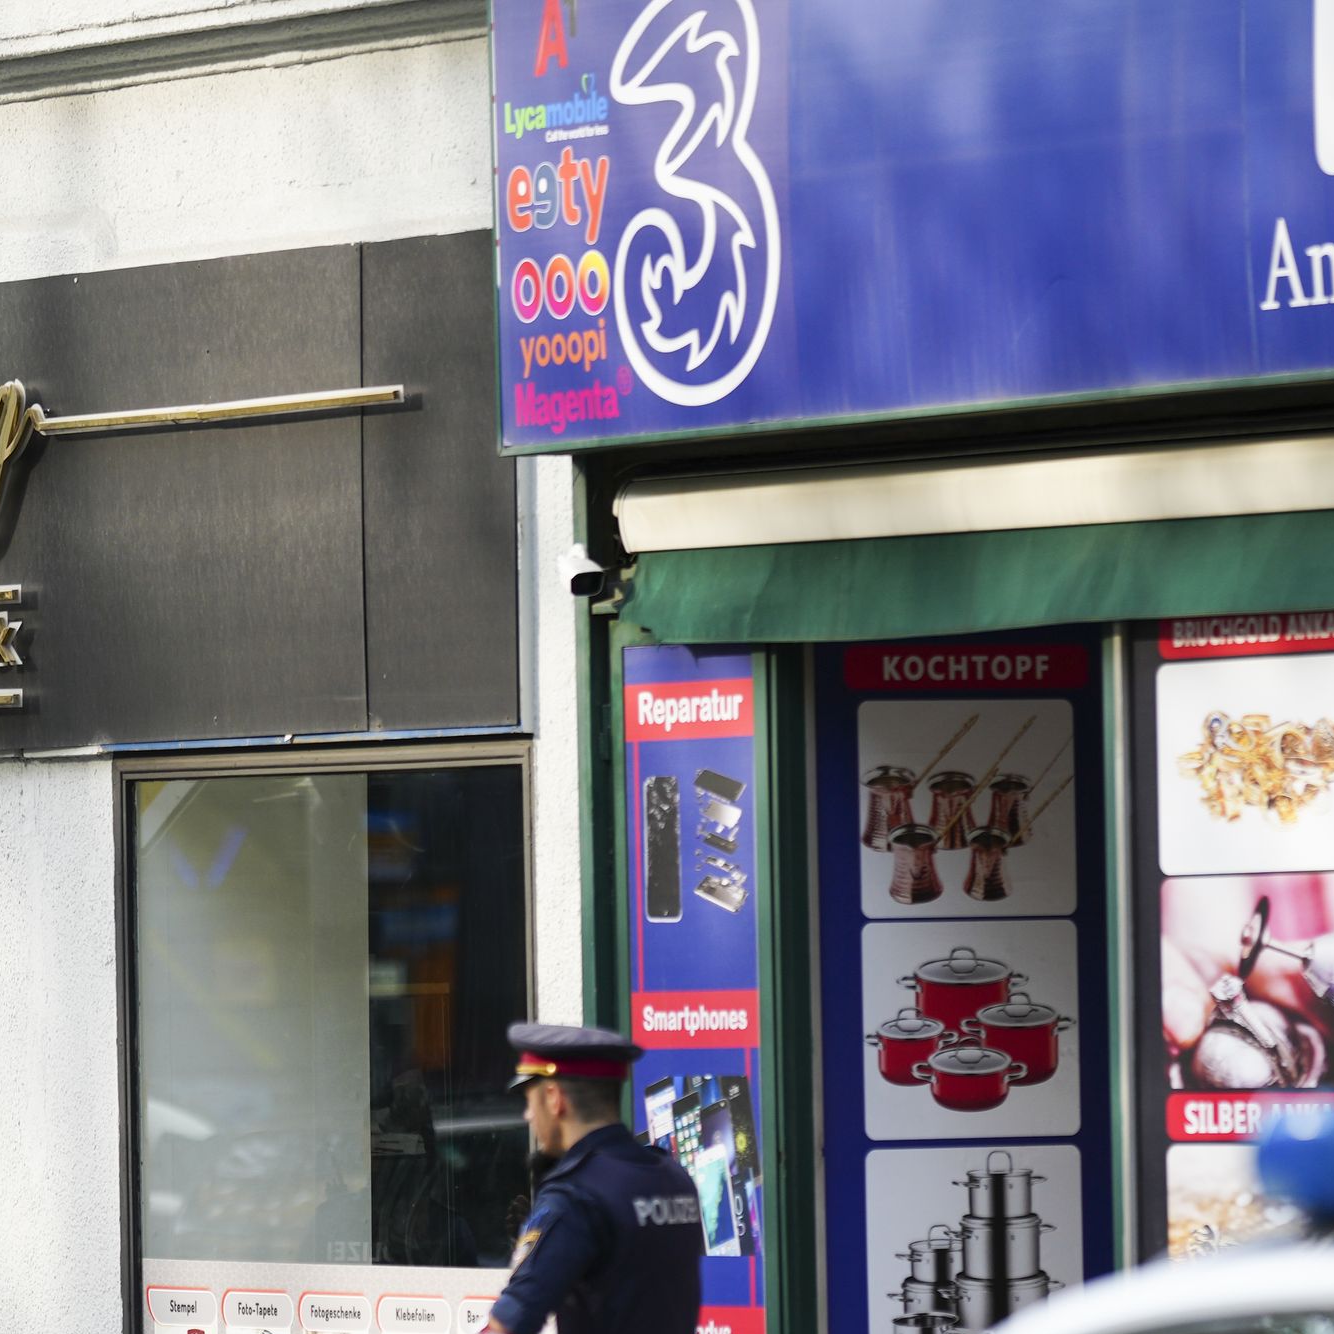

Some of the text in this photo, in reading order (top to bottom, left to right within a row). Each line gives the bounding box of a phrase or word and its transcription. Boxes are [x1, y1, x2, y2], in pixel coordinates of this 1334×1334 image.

[504, 91, 608, 138] Lycamobile
[520, 318, 608, 379] yooopi
[1173, 615, 1281, 648] BRUCHGOLD
[882, 654, 1051, 682] KOCHTOPF
[638, 689, 743, 732] Reparatur
[642, 1004, 748, 1037] Smartphones
[1183, 1099, 1262, 1134] SILBER
[169, 1300, 197, 1314] Stempel
[237, 1303, 278, 1319] Foto-Tapete
[310, 1305, 361, 1321] Fotogeschenke
[395, 1308, 435, 1322] Klebefolien
